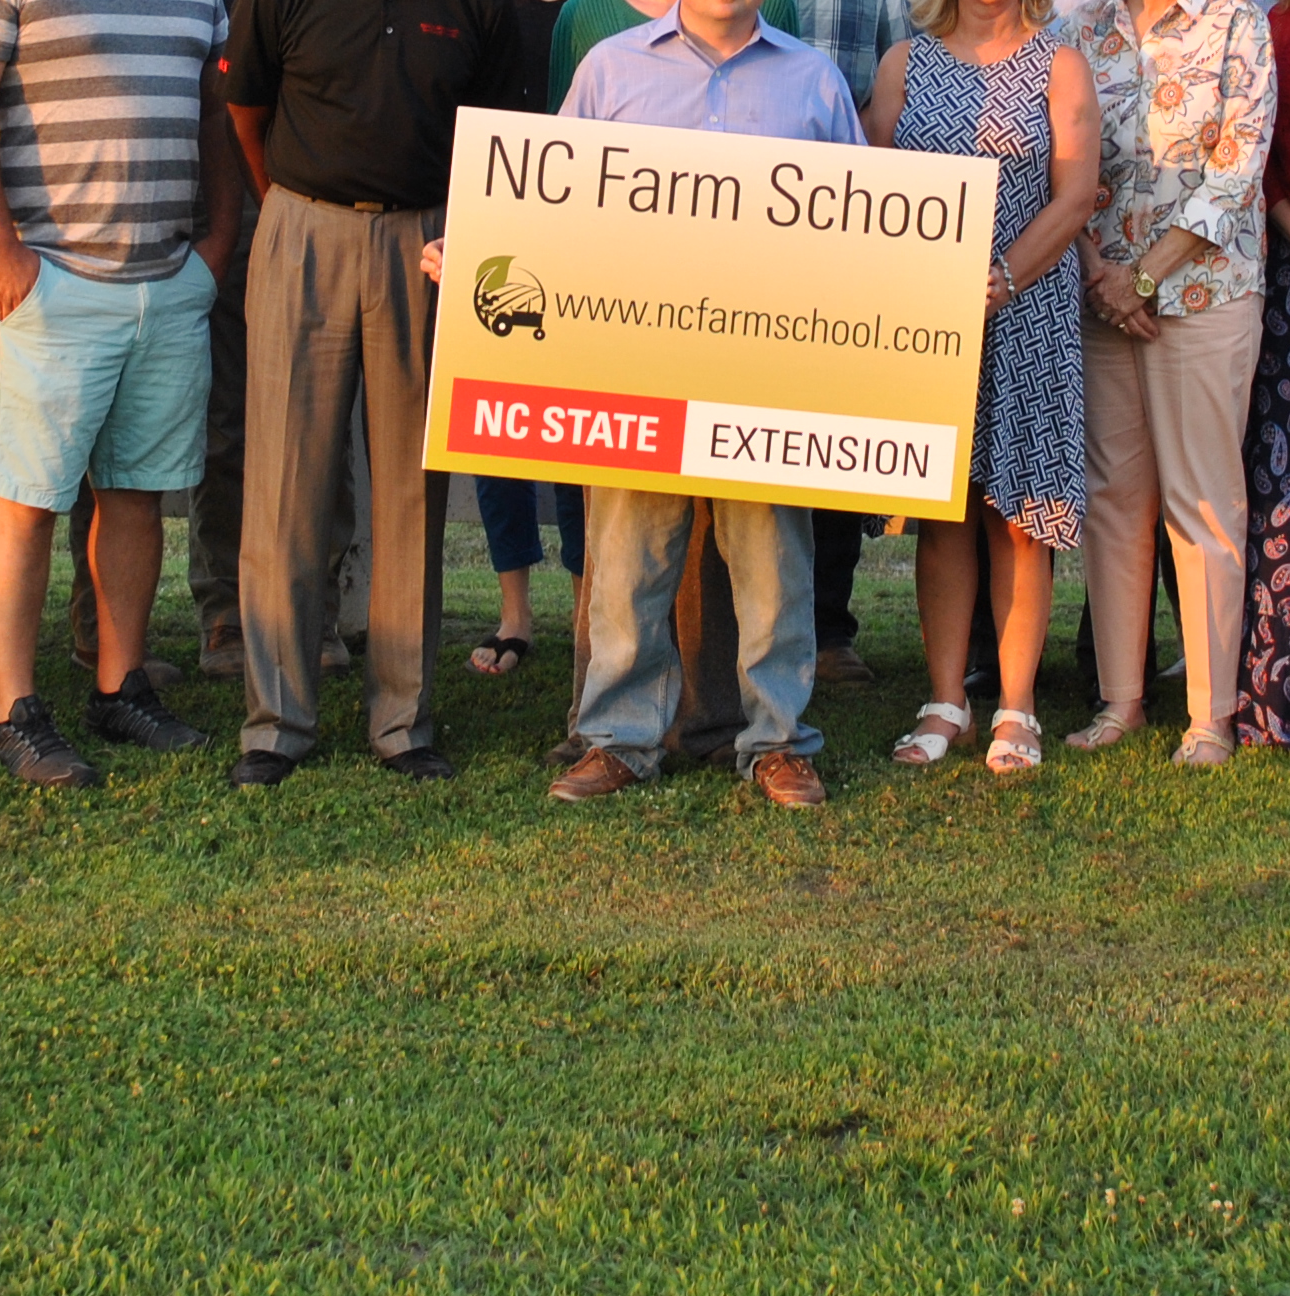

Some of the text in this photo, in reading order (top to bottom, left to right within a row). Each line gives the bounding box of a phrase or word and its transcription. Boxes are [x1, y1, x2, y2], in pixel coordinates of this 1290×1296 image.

[485, 135, 967, 243] NC Farm School
[555, 292, 961, 357] www.ncfarmschool.com
[473, 399, 930, 478] NC STATE EXTENSION
